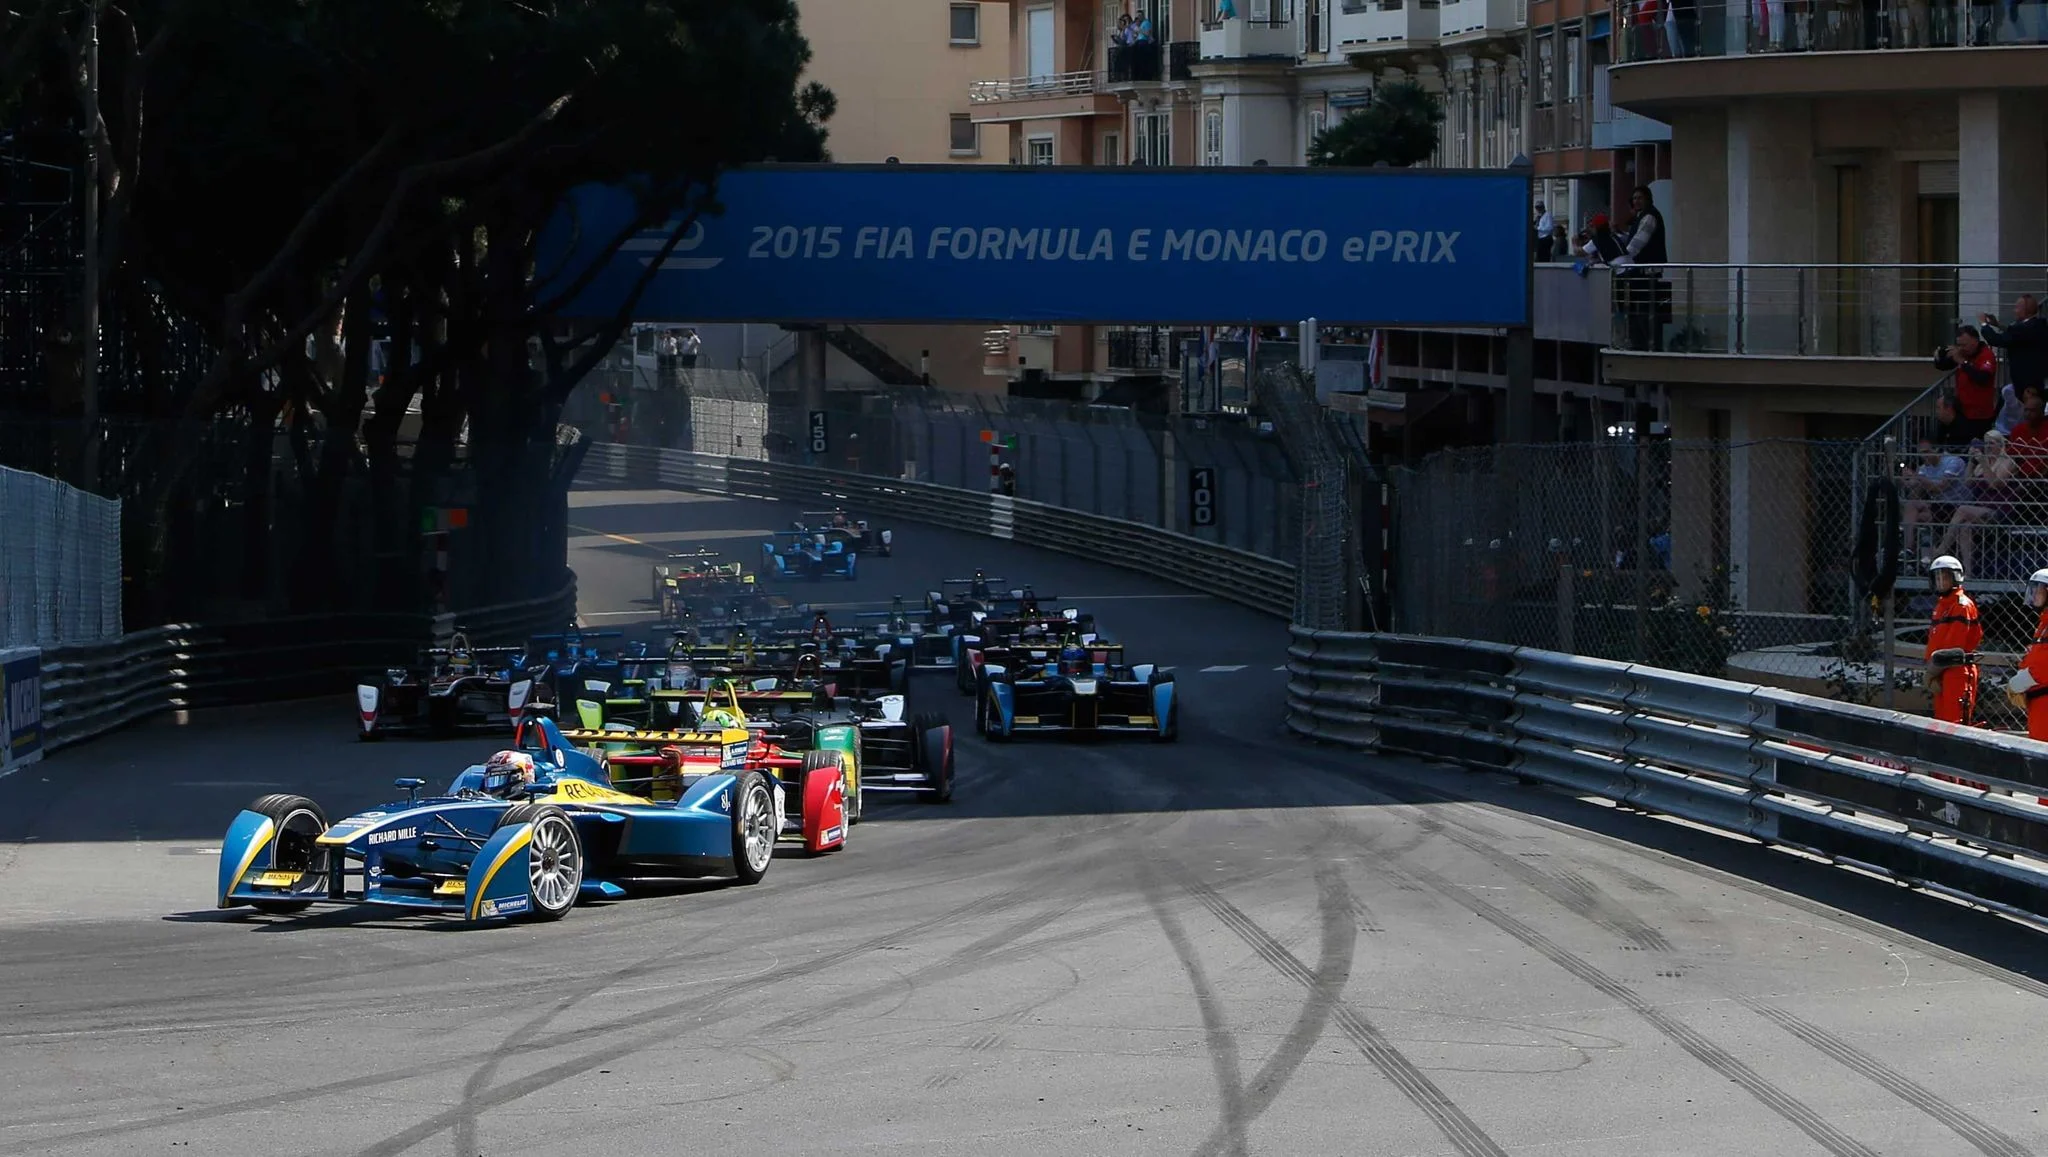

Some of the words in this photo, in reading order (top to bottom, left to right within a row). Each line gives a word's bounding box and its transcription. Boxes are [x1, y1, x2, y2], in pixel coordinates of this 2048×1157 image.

[748, 226, 843, 258] 2015
[854, 226, 914, 259] FIA
[927, 227, 1114, 260] FORMULA
[1127, 229, 1151, 260] E
[1161, 229, 1328, 261] MONACO
[1342, 230, 1462, 263] ePRIX
[814, 413, 825, 451] 150
[1195, 471, 1211, 523] 100
[368, 830, 397, 845] RICHARD
[397, 826, 417, 841] MILLE
